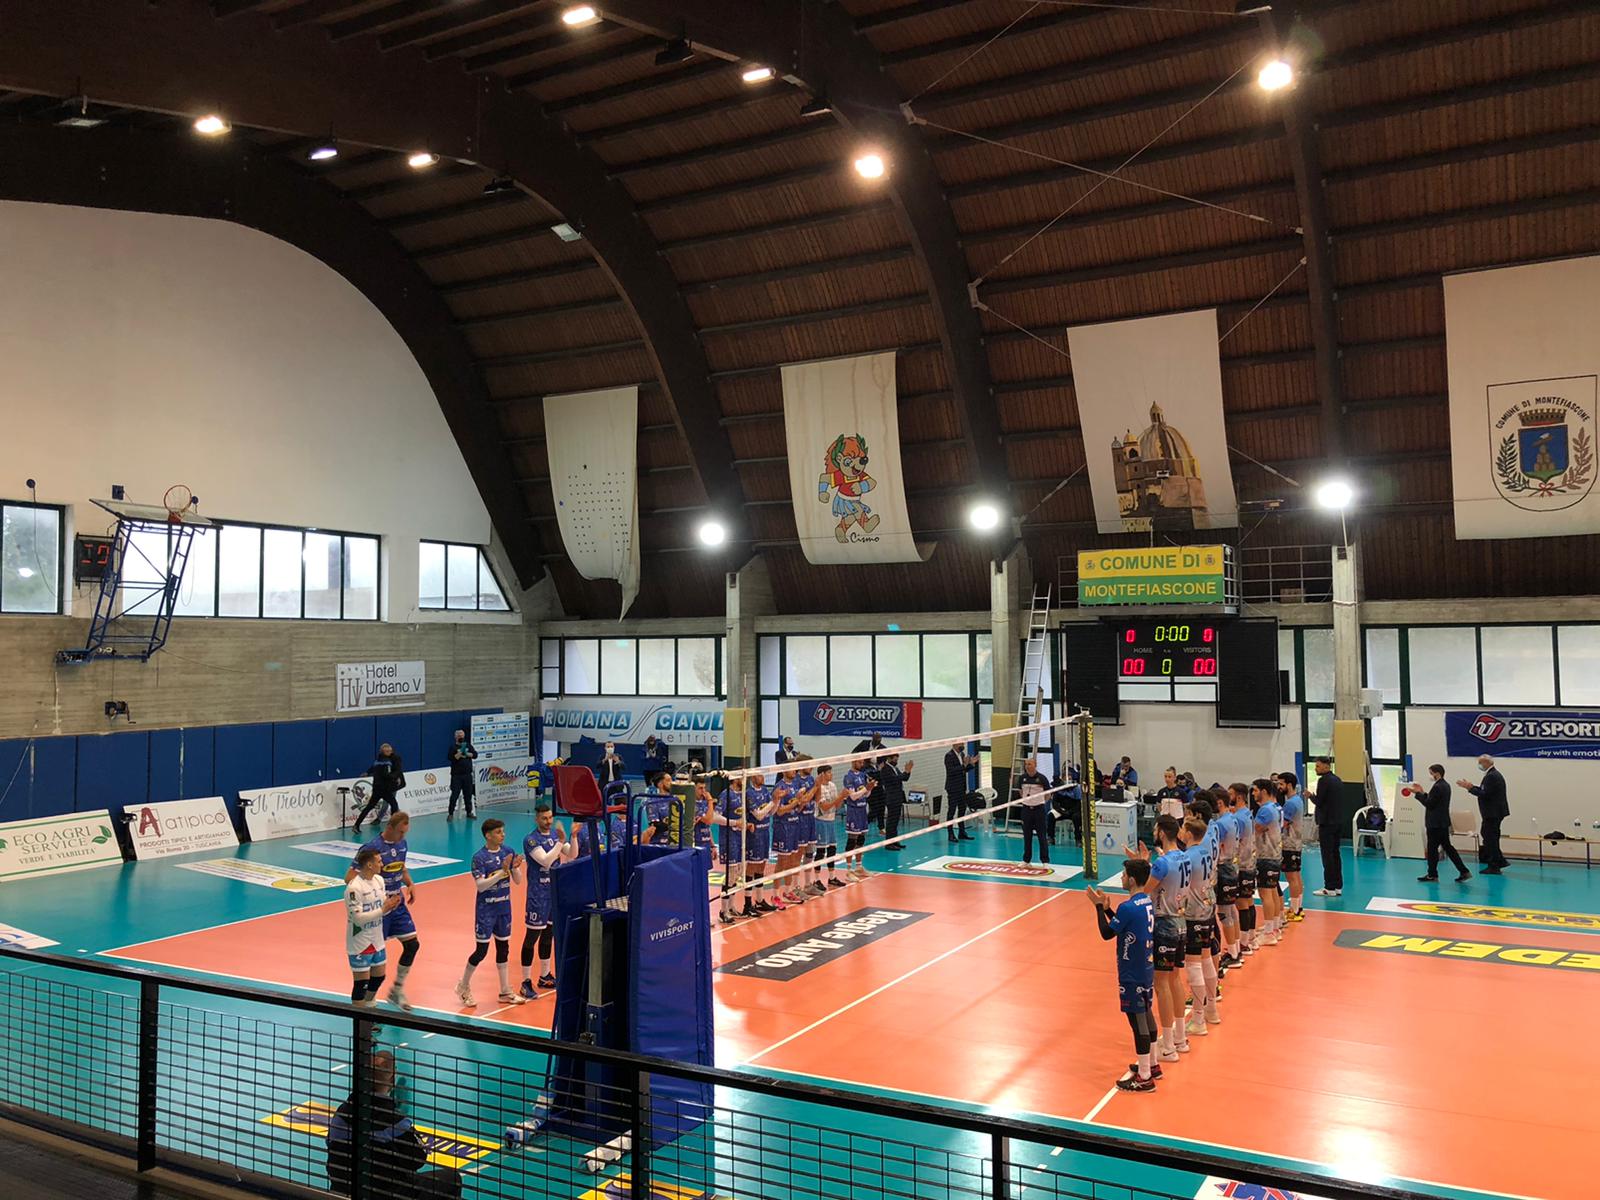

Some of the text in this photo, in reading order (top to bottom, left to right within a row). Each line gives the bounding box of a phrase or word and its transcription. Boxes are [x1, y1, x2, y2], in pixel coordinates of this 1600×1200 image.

[1495, 396, 1590, 429] COMUNE DI MONTEFIASCONE
[849, 532, 880, 543] Cismo
[1100, 554, 1200, 571] COMUNE DI
[1084, 581, 1217, 598] MONTEFIASCONE
[1126, 625, 1214, 643] 0 0:00 0
[1183, 646, 1212, 654] VISITORS
[365, 664, 398, 679] Hotel
[1123, 658, 1216, 675] 00 0 00
[366, 678, 421, 695] Urbano V
[544, 711, 629, 728] ROMANA
[659, 731, 718, 744] lettric
[270, 789, 324, 812] Trebbo
[403, 786, 451, 799] EUROSPURG
[139, 807, 226, 838] A atipico
[12, 825, 91, 847] ECO AGRI
[139, 839, 170, 848] PRODOTTI
[194, 831, 231, 841] ARTIGIANATO
[22, 838, 88, 854] SERVICE
[18, 855, 45, 864] VERDE
[529, 911, 537, 921] 10
[650, 920, 694, 941] VIVISPORT
[754, 910, 913, 968] Regie Auto
[1360, 934, 1600, 970] EDEM
